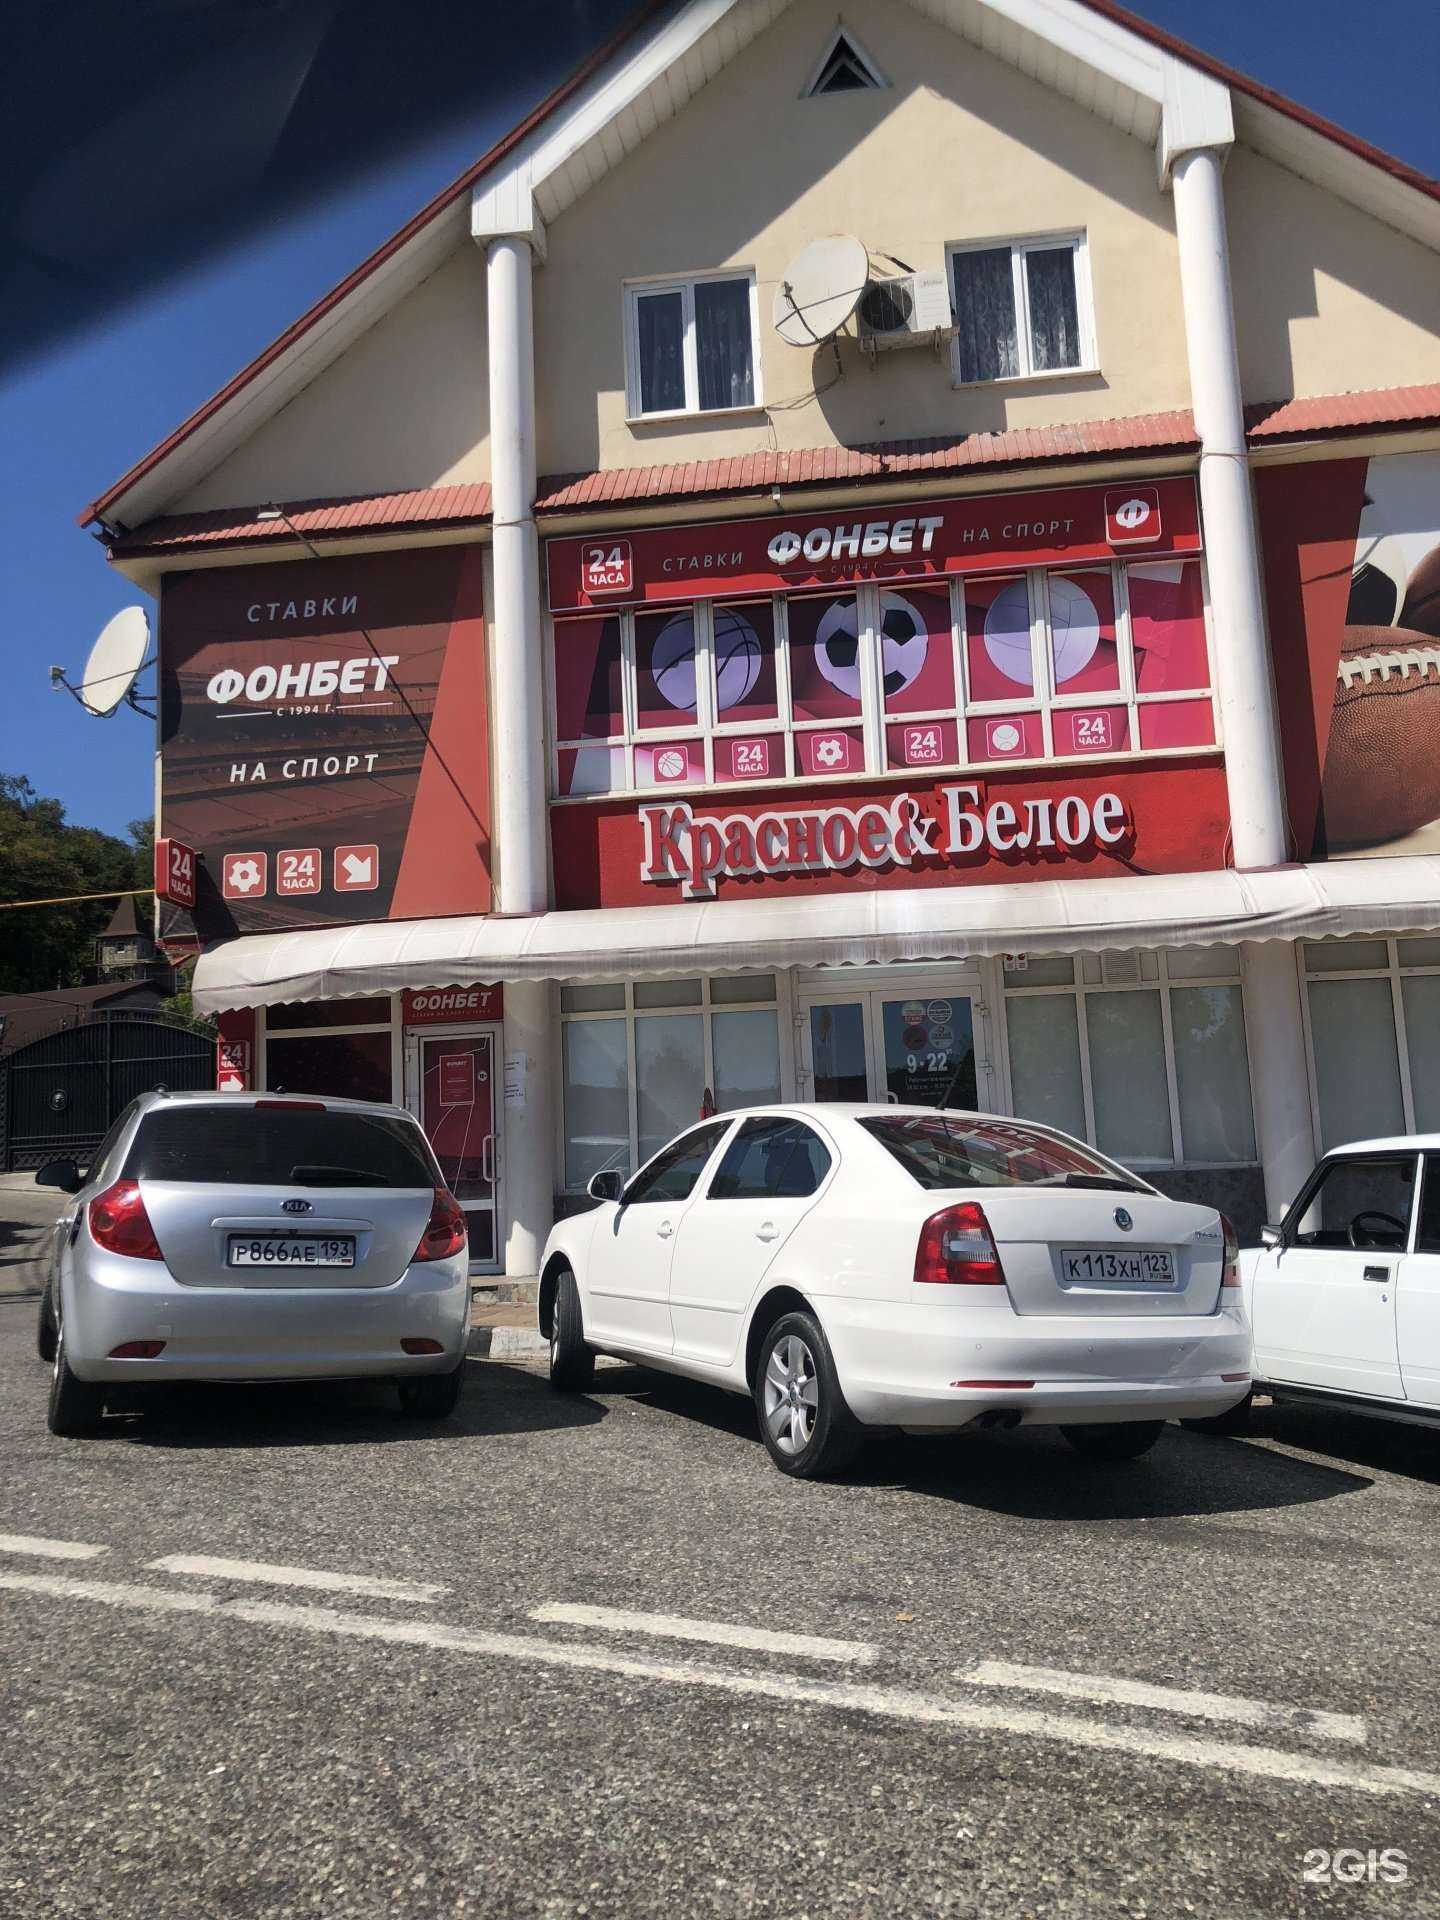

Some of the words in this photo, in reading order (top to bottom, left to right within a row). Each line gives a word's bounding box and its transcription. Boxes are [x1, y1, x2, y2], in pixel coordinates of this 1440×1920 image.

[663, 552, 743, 572] СТАВКИ
[767, 516, 944, 565] ФОНБЕТ
[963, 528, 990, 542] НА
[1002, 519, 1075, 538] СПОРТ
[589, 547, 624, 573] 24
[589, 573, 625, 585] ЧАСА
[248, 596, 358, 623] СТАВКИ
[207, 656, 399, 703] ФОНБЕТ
[277, 707, 284, 717] С
[290, 705, 319, 716] 1994
[1078, 717, 1105, 736] 24
[910, 731, 937, 749] 24
[1078, 735, 1106, 745] ЧАСА
[737, 745, 763, 763] 24
[910, 749, 937, 759] ЧАСА
[230, 763, 267, 783] НА
[282, 754, 379, 779] СПОРТ
[737, 763, 764, 772] ЧАСА
[639, 786, 1125, 897] Красное&Белое
[171, 848, 192, 881] 24
[283, 855, 315, 877] 24
[171, 879, 192, 897] ЧАСА
[283, 878, 315, 889] ЧАСА
[411, 992, 492, 1011] ФОНБЕТ
[222, 1044, 243, 1060] 24
[286, 1202, 308, 1211] KIA
[236, 1241, 316, 1262] Р866АЕ
[321, 1242, 349, 1257] 193
[1069, 1254, 1141, 1278] К113ХН
[1144, 1254, 1168, 1271] 123
